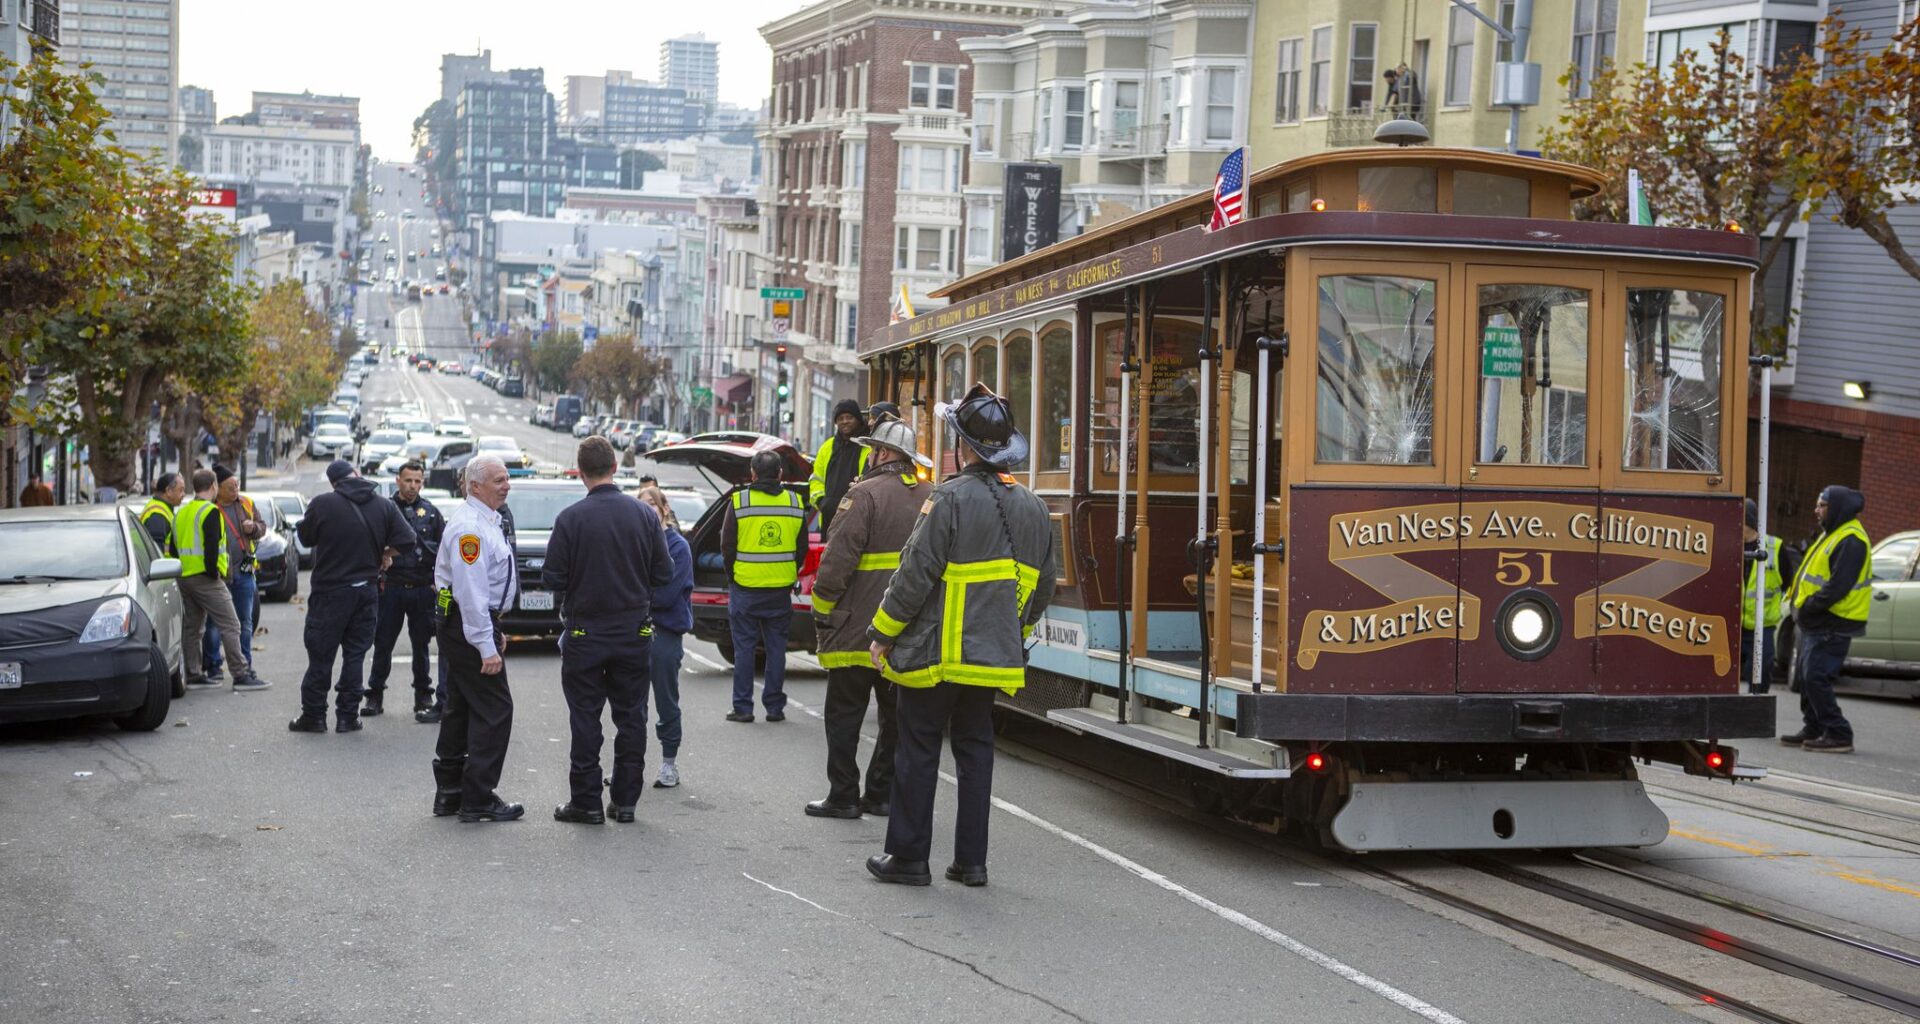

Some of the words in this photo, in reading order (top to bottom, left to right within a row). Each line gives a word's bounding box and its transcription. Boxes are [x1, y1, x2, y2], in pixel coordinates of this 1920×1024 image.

[1025, 172, 1041, 180] THE
[1152, 245, 1162, 264] 51
[978, 299, 990, 316] HILL
[1028, 281, 1043, 300] NESS
[1066, 263, 1110, 290] CALIFORNIA
[1338, 518, 1393, 548] Van
[1398, 512, 1473, 542] Ness
[1568, 512, 1708, 554] California
[1495, 552, 1559, 586] 51
[1046, 624, 1078, 647] RAILWAY
[1319, 614, 1344, 643] &
[1350, 601, 1465, 645] Market
[1598, 600, 1713, 645] Streets
